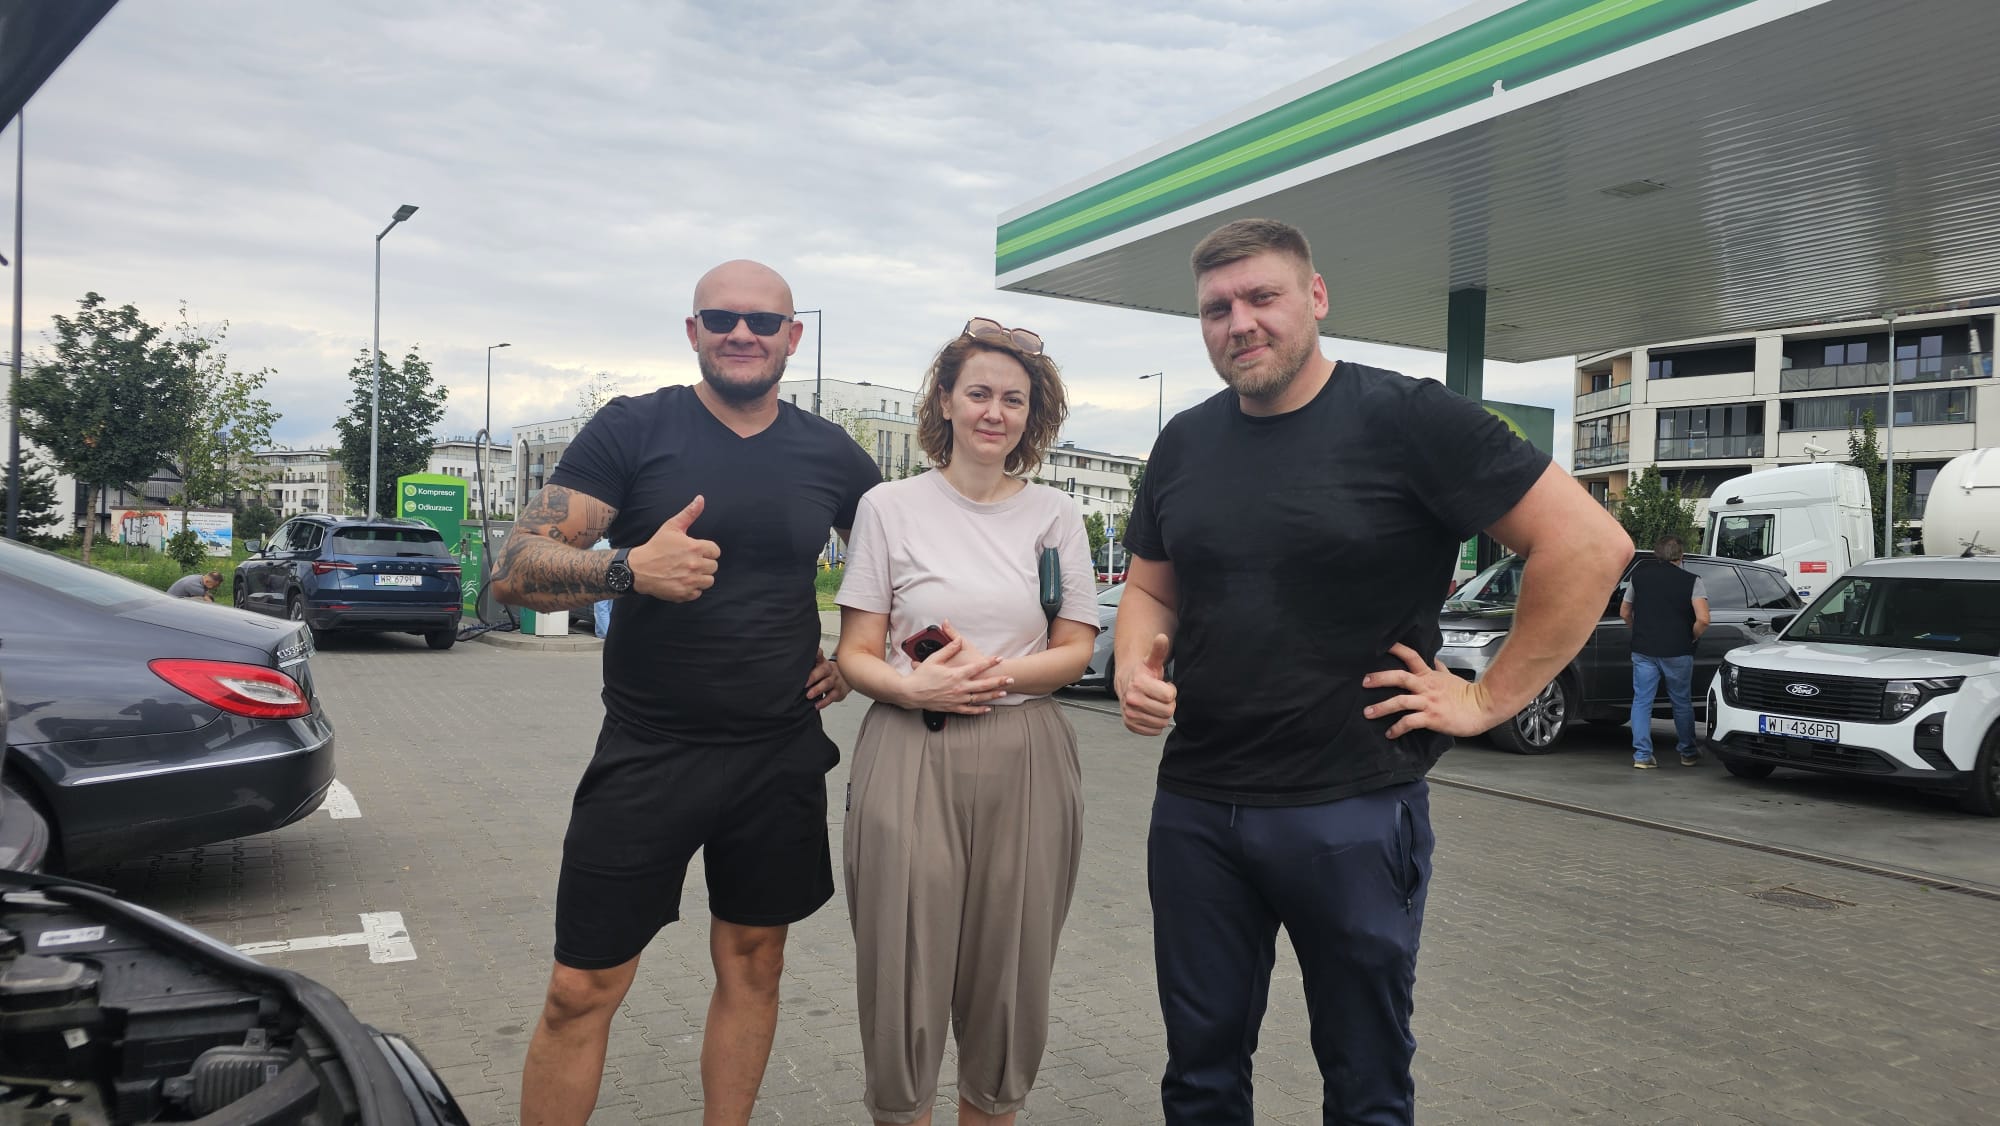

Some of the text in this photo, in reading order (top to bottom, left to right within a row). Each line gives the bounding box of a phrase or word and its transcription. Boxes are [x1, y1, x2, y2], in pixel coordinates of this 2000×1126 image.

[418, 488, 456, 497] Kompresor
[417, 503, 454, 512] Odkurzacz
[380, 575, 391, 583] WR
[1769, 718, 1783, 732] WI
[1791, 721, 1835, 738] 436PR
